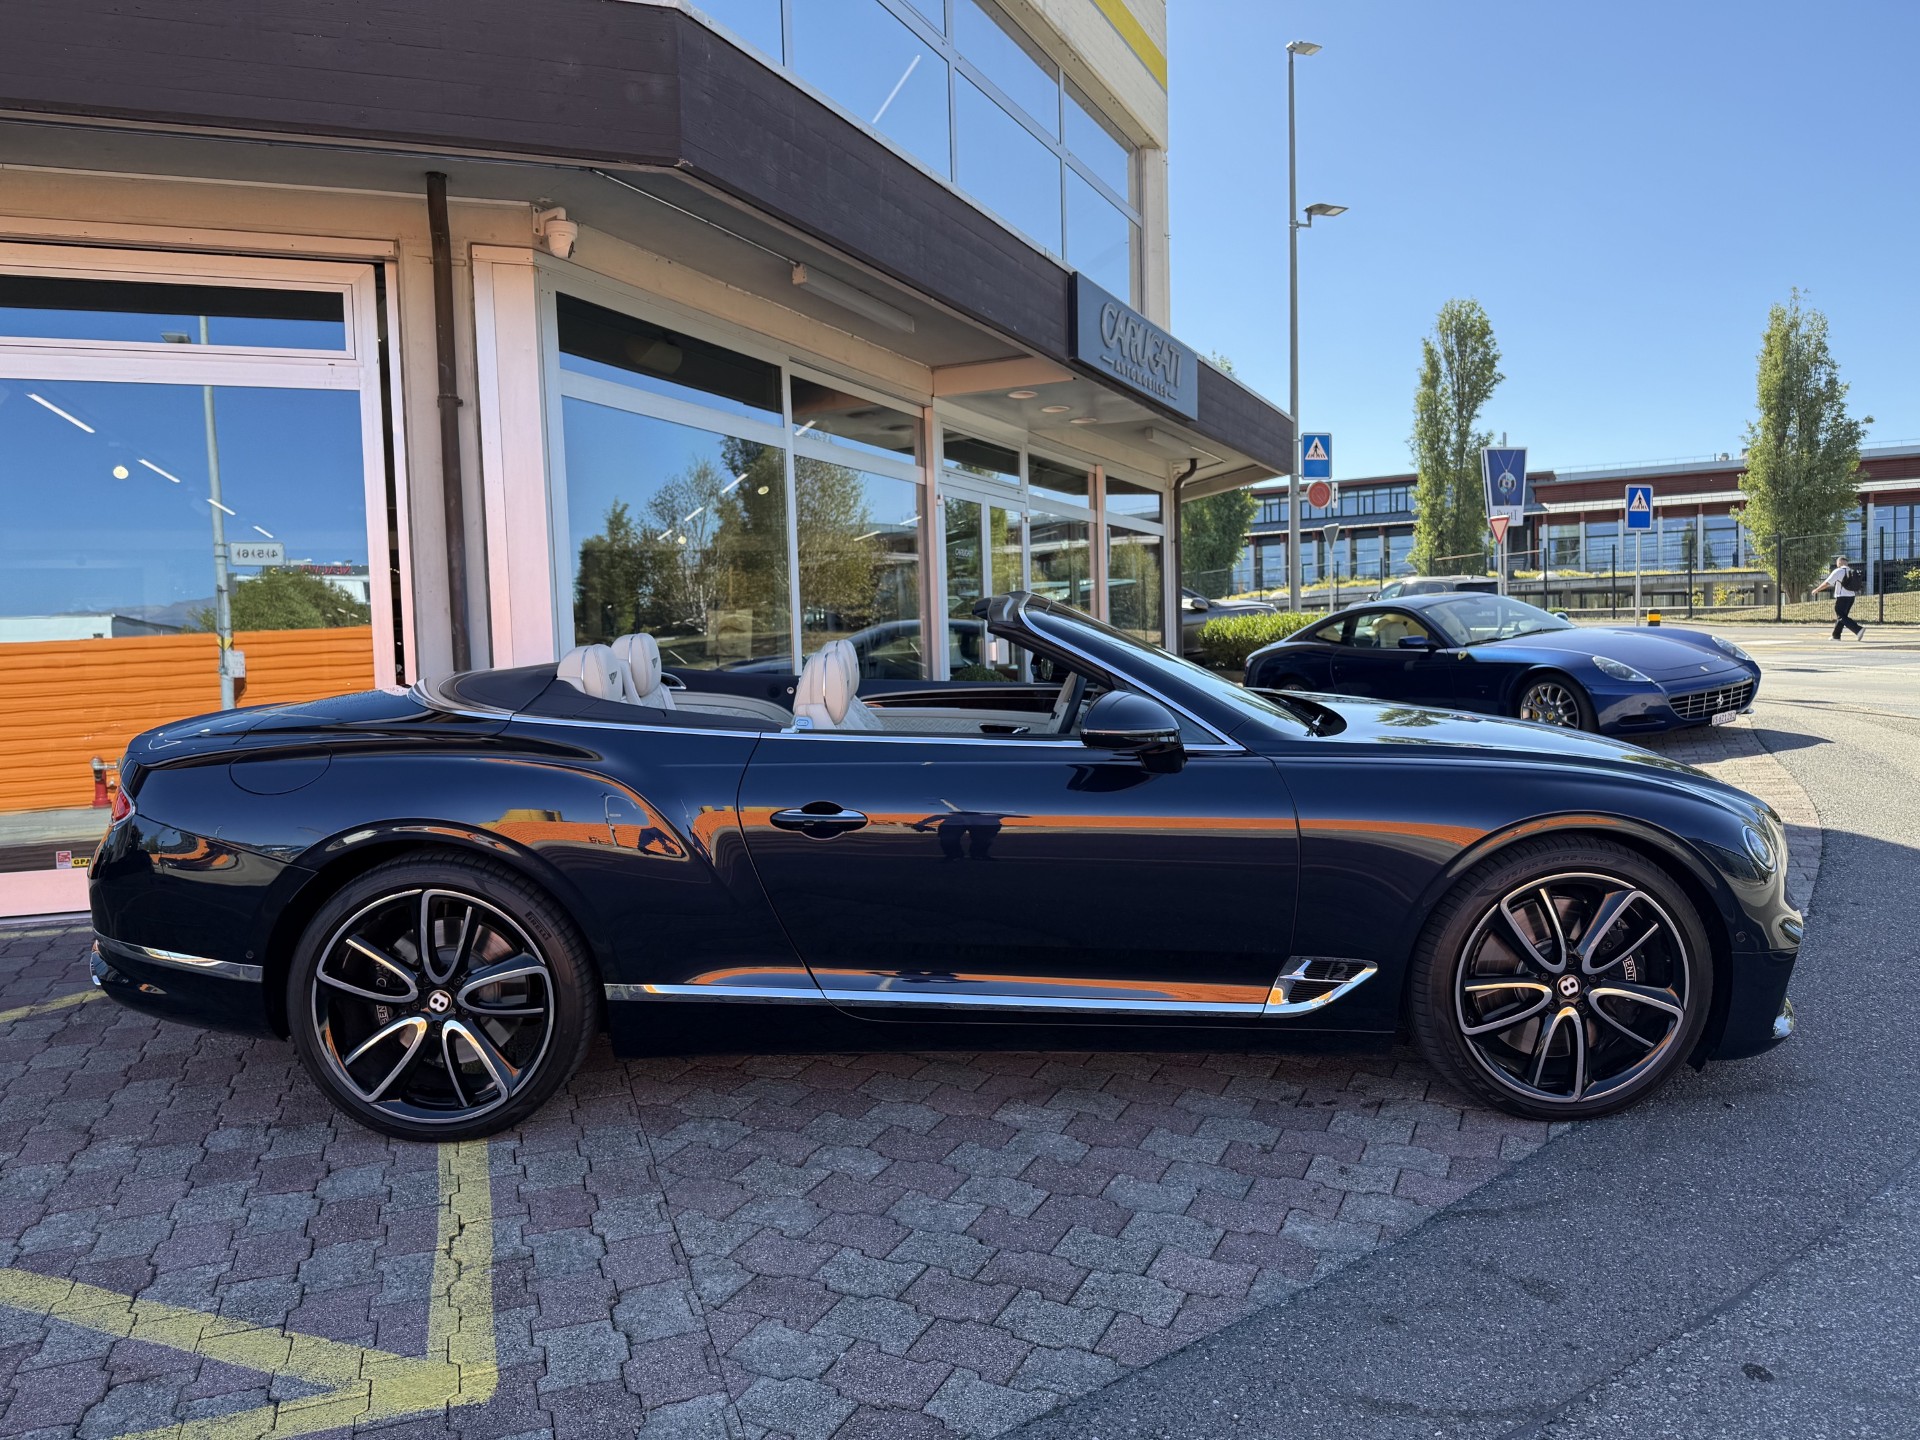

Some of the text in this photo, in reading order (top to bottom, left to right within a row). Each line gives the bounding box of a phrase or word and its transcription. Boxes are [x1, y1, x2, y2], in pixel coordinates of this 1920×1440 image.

[1101, 302, 1182, 388] CARUGATI
[1113, 360, 1168, 398] AUTOMOBILES
[525, 911, 552, 941] PIRELLI
[1324, 962, 1349, 980] 12
[1560, 977, 1579, 997] B
[429, 992, 449, 1012] B
